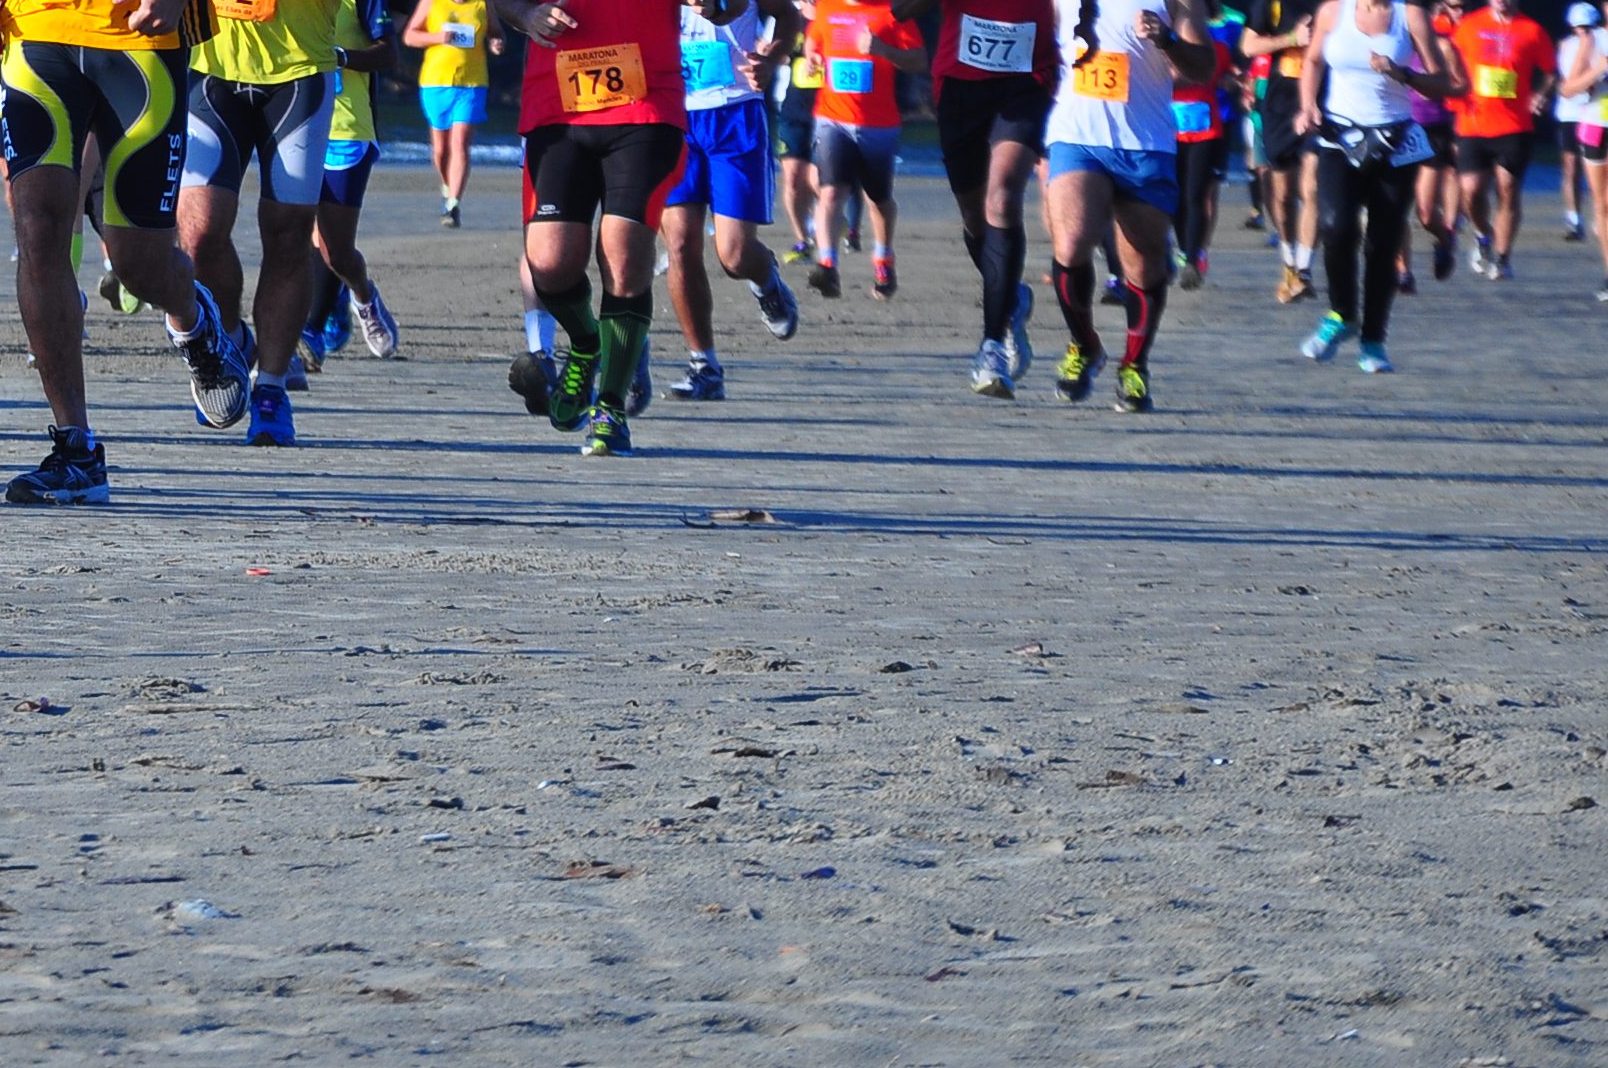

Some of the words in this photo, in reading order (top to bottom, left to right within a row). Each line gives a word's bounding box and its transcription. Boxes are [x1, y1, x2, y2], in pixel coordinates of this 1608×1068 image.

[568, 49, 619, 62] MARATONA
[968, 35, 1017, 61] 677
[568, 66, 625, 96] 178
[839, 70, 859, 84] 29
[159, 133, 184, 212] FLETS
